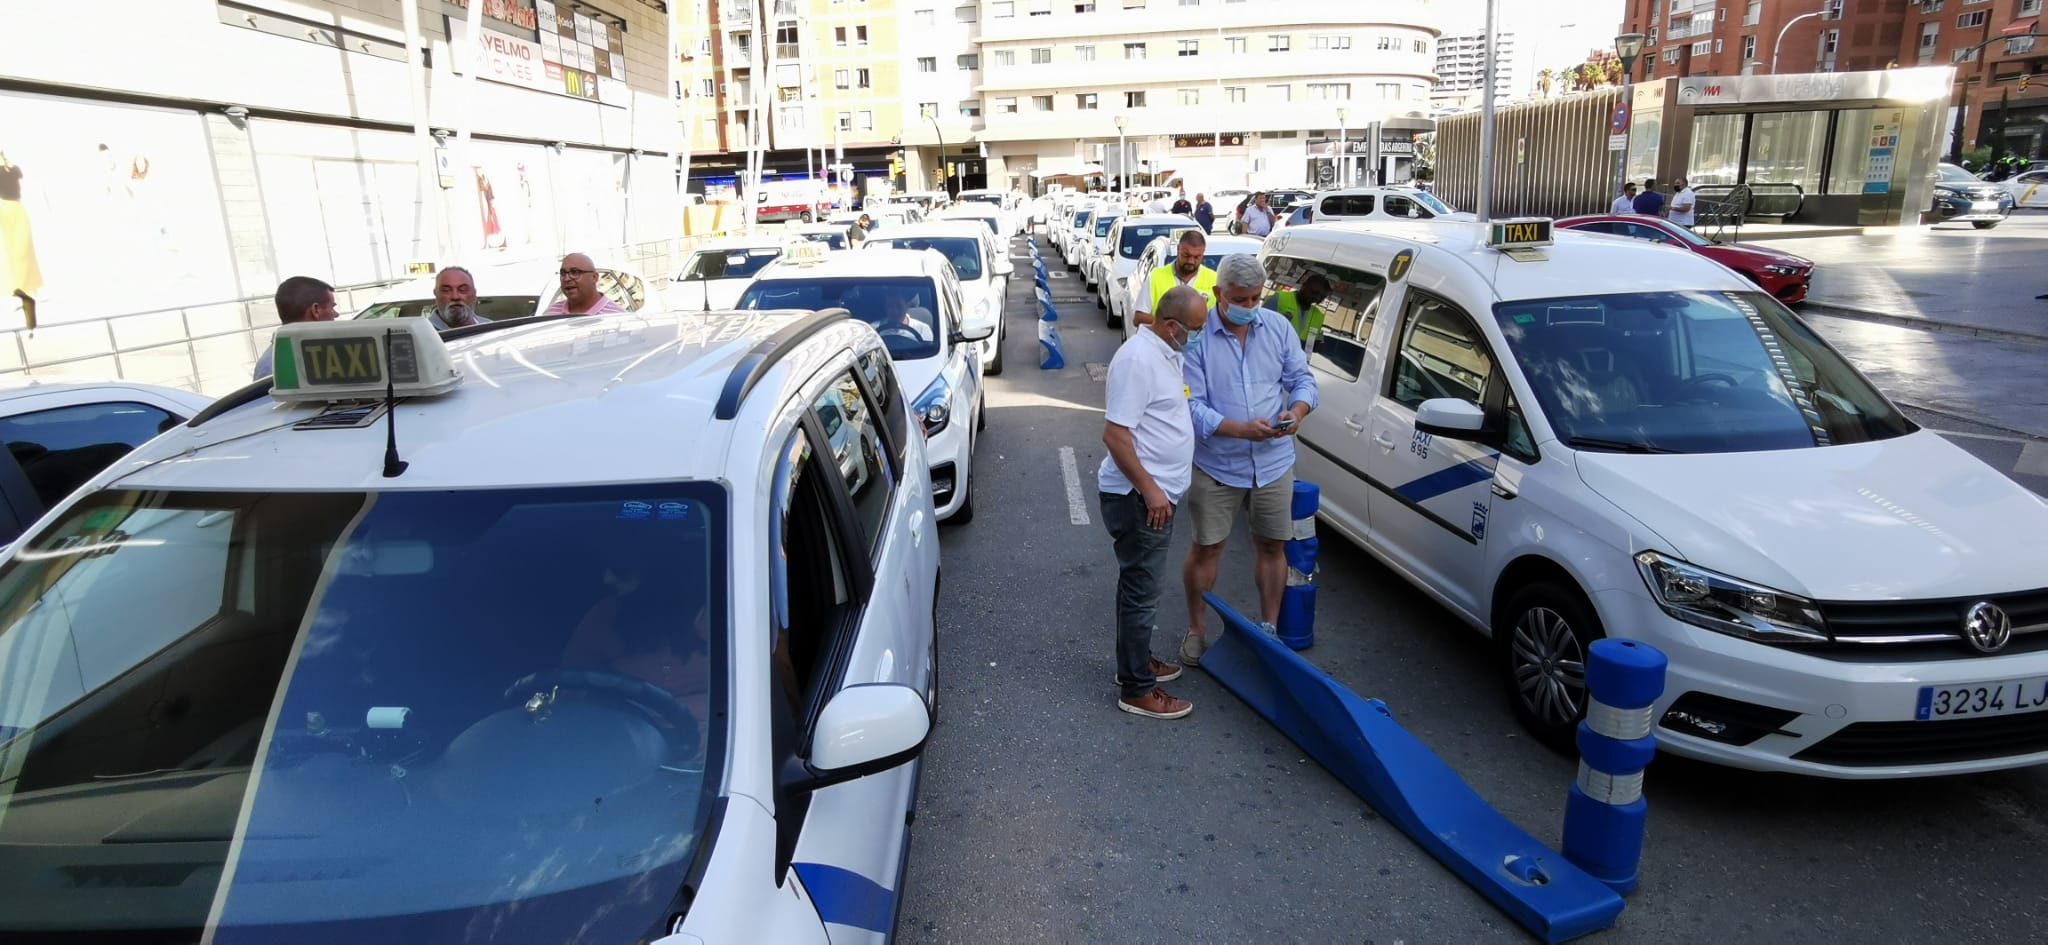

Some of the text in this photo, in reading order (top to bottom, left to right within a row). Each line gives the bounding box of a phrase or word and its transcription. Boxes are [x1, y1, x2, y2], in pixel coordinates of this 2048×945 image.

[483, 34, 531, 61] YELMO
[493, 58, 533, 81] CNES
[1352, 141, 1391, 153] EMPDAS
[1506, 223, 1538, 242] TAXI
[1394, 255, 1409, 276] T
[305, 343, 379, 380] TAXI
[1412, 430, 1433, 447] TAXI
[1411, 441, 1429, 460] 895
[1935, 685, 2004, 715] 3234
